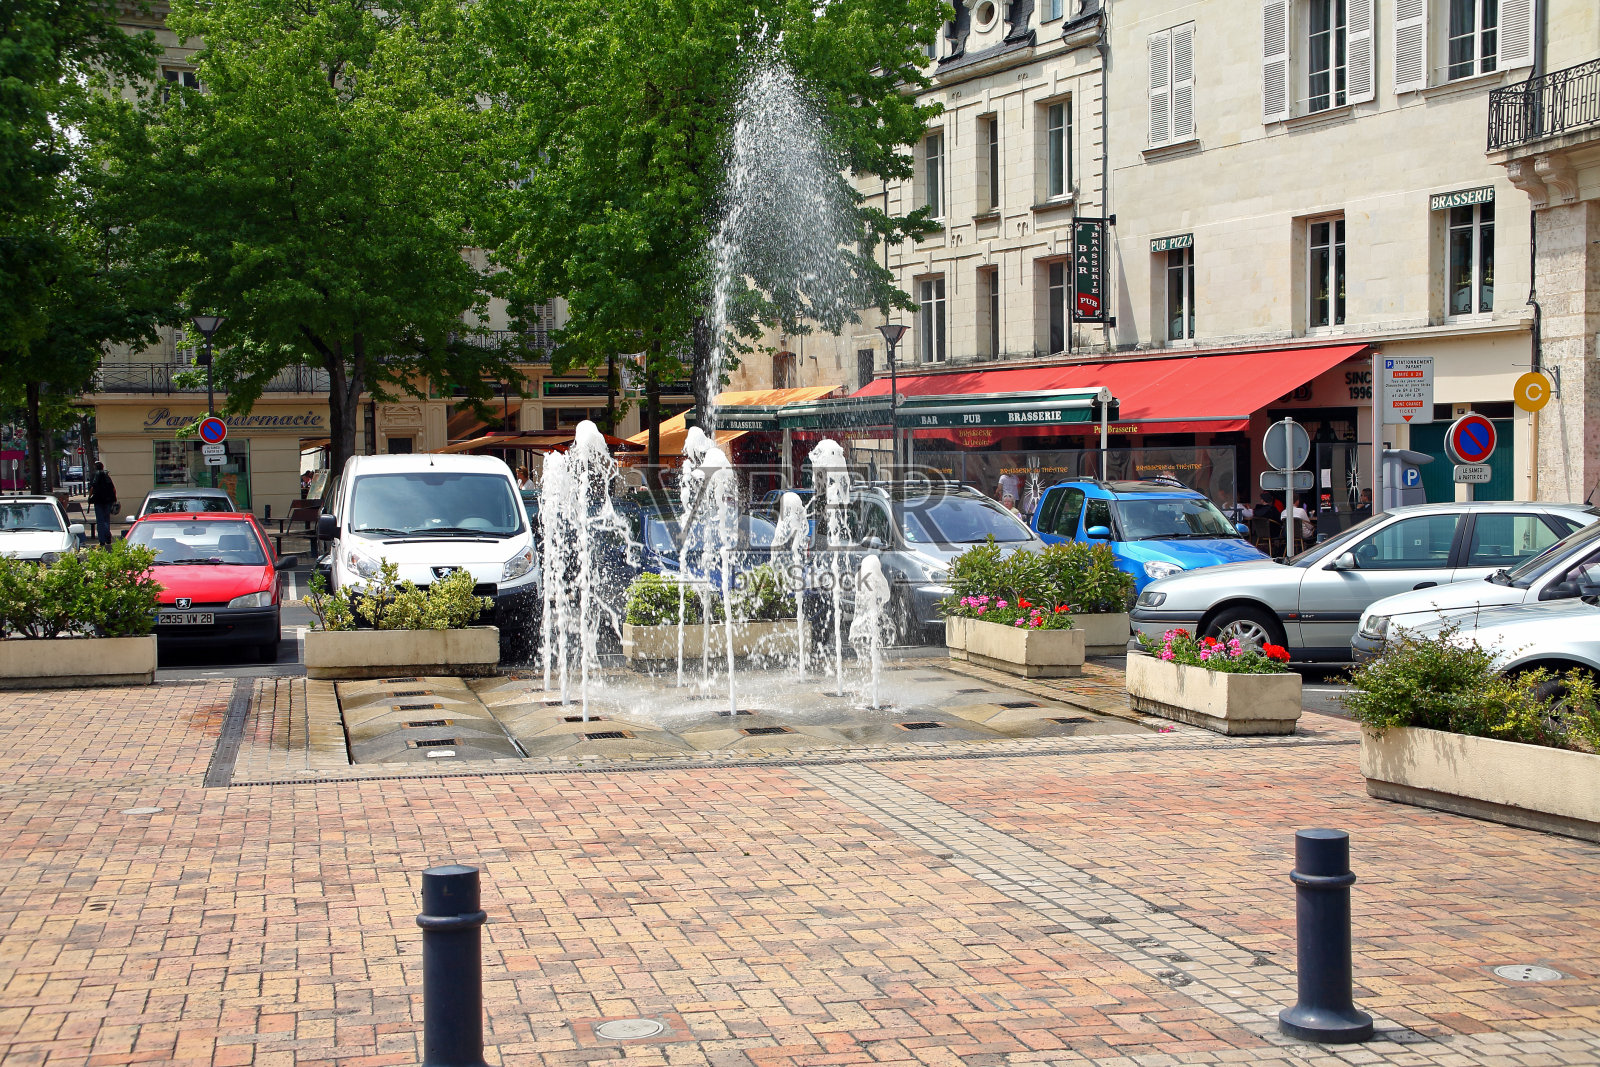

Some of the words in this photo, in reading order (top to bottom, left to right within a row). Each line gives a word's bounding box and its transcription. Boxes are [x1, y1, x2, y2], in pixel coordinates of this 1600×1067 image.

[1432, 187, 1494, 209] BRASSERIE
[1151, 240, 1166, 251] PUB
[1170, 235, 1192, 248] PIZZA
[1078, 244, 1088, 274] BAR
[1091, 231, 1099, 294] BRASSERIE
[1080, 297, 1098, 308] PUB
[1345, 371, 1372, 385] SINC
[1349, 386, 1372, 400] 1996
[1526, 383, 1542, 401] C
[730, 421, 763, 429] BRASSERIE
[921, 415, 938, 425] BAR
[963, 414, 981, 424] PUB
[1008, 411, 1062, 422] BRASSERIE
[1108, 424, 1138, 433] Brasserie
[186, 614, 198, 624] VW
[200, 613, 212, 624] 28
